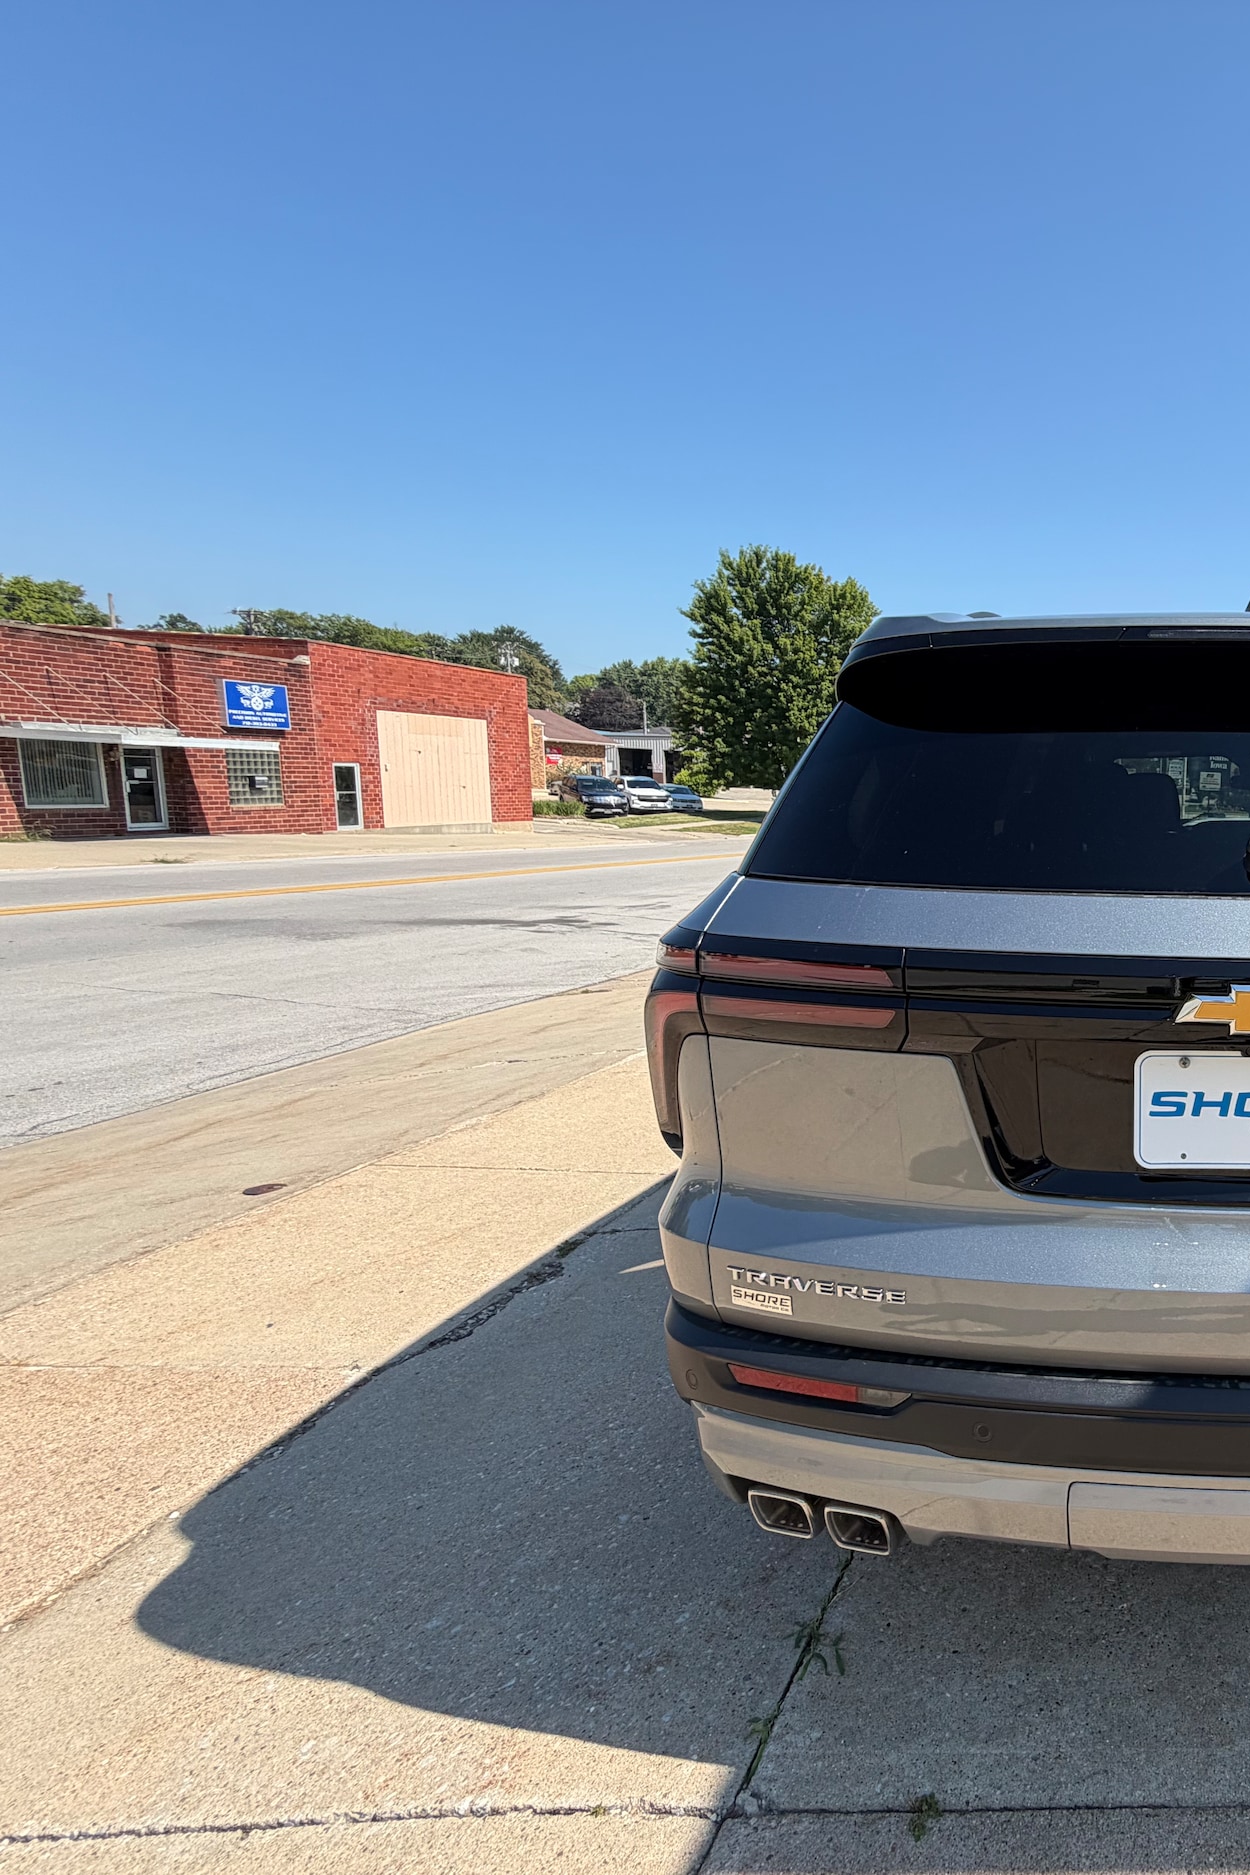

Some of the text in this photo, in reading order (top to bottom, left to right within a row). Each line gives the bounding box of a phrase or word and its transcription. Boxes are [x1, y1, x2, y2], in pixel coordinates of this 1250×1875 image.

[1210, 761, 1228, 769] Iowa
[726, 1265, 907, 1305] TRAVERSE
[732, 1288, 791, 1308] SHORE
